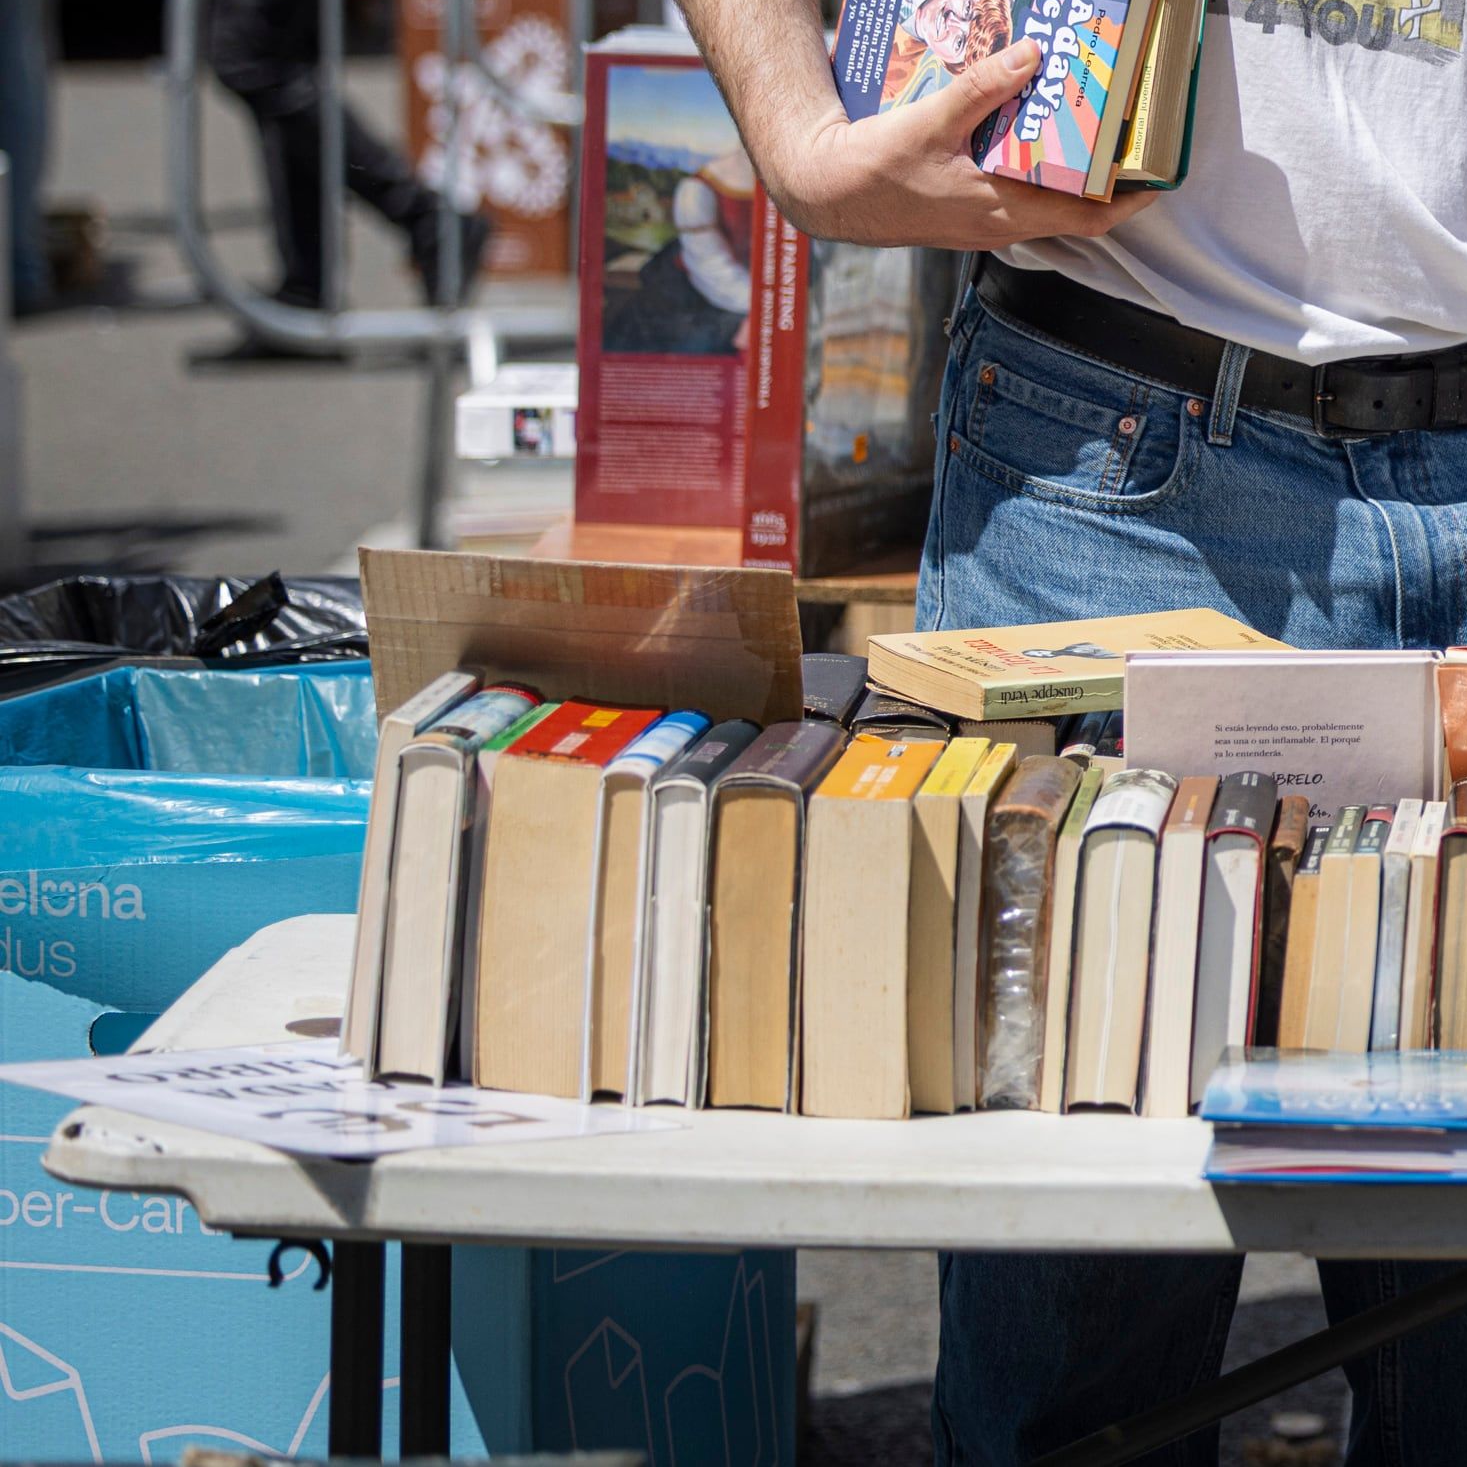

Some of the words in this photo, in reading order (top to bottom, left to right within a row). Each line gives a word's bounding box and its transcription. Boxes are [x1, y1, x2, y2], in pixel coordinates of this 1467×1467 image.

[846, 4, 857, 22] yo.
[858, 2, 868, 17] de
[862, 9, 874, 32] que
[853, 19, 864, 37] los
[870, 16, 883, 46] John
[1090, 9, 1106, 48] Pedro
[844, 38, 860, 83] Beatles
[856, 33, 870, 70] cierra
[853, 71, 862, 82] el
[860, 47, 876, 93] Lennon
[1037, 27, 1080, 111] day
[1075, 52, 1096, 107] Learreta
[1021, 102, 1050, 141] in
[1134, 117, 1145, 161] editorial
[1001, 690, 1029, 705] Verdi
[1032, 684, 1085, 700] Giuseppe
[1215, 724, 1223, 732] Si
[1225, 724, 1244, 732] estás
[1247, 724, 1278, 733] leyendo
[1281, 725, 1299, 733] esto,
[1302, 723, 1364, 732] probablemente
[1272, 736, 1318, 744] inflamable.
[1331, 736, 1361, 746] porqué
[1236, 750, 1283, 758] entenderás.
